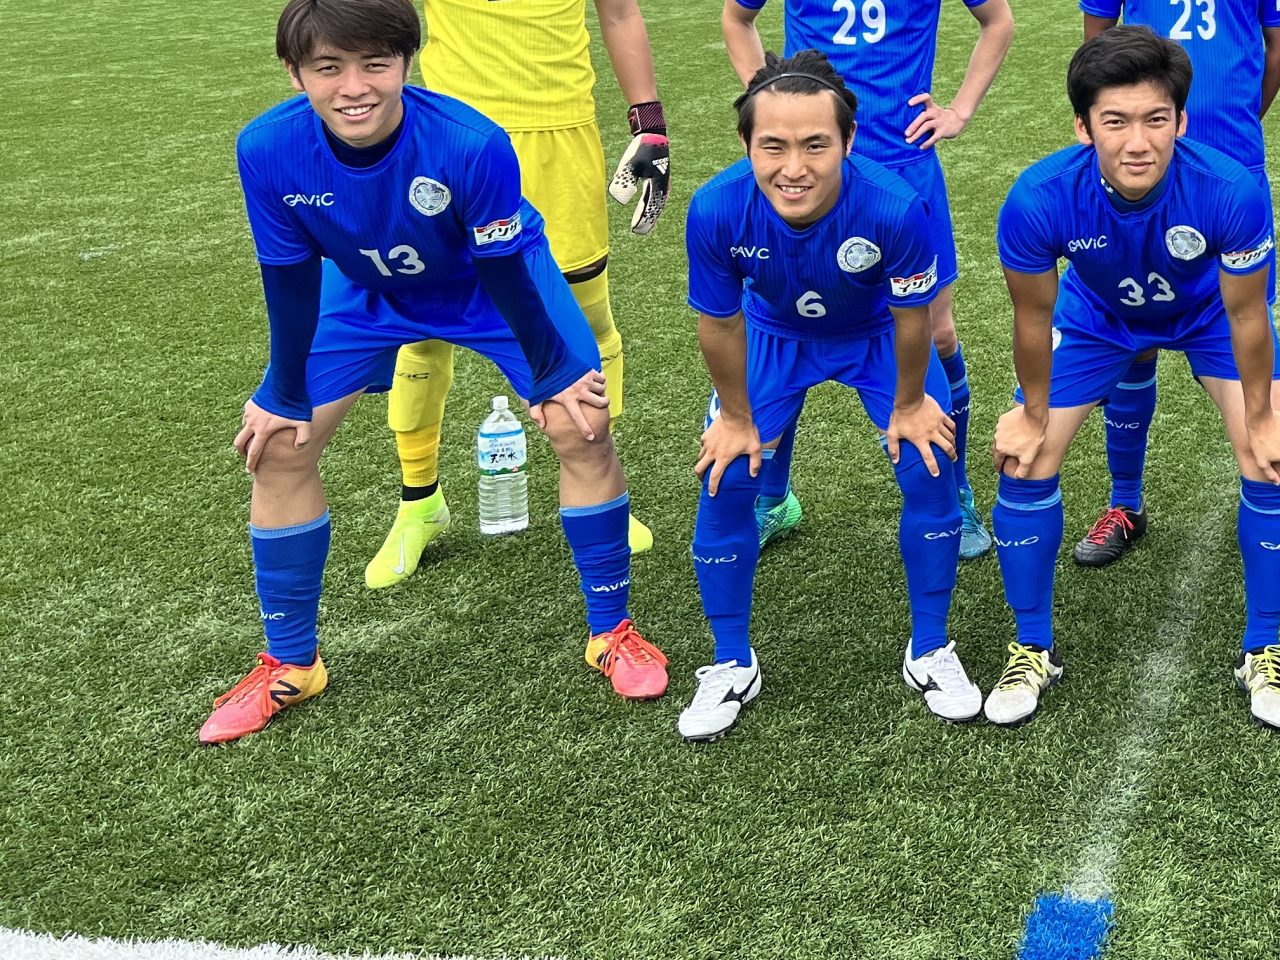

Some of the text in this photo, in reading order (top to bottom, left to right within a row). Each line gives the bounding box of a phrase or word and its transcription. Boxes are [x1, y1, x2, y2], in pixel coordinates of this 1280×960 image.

[358, 244, 426, 277] 13
[795, 289, 827, 318] 6
[1117, 271, 1176, 307] 33
